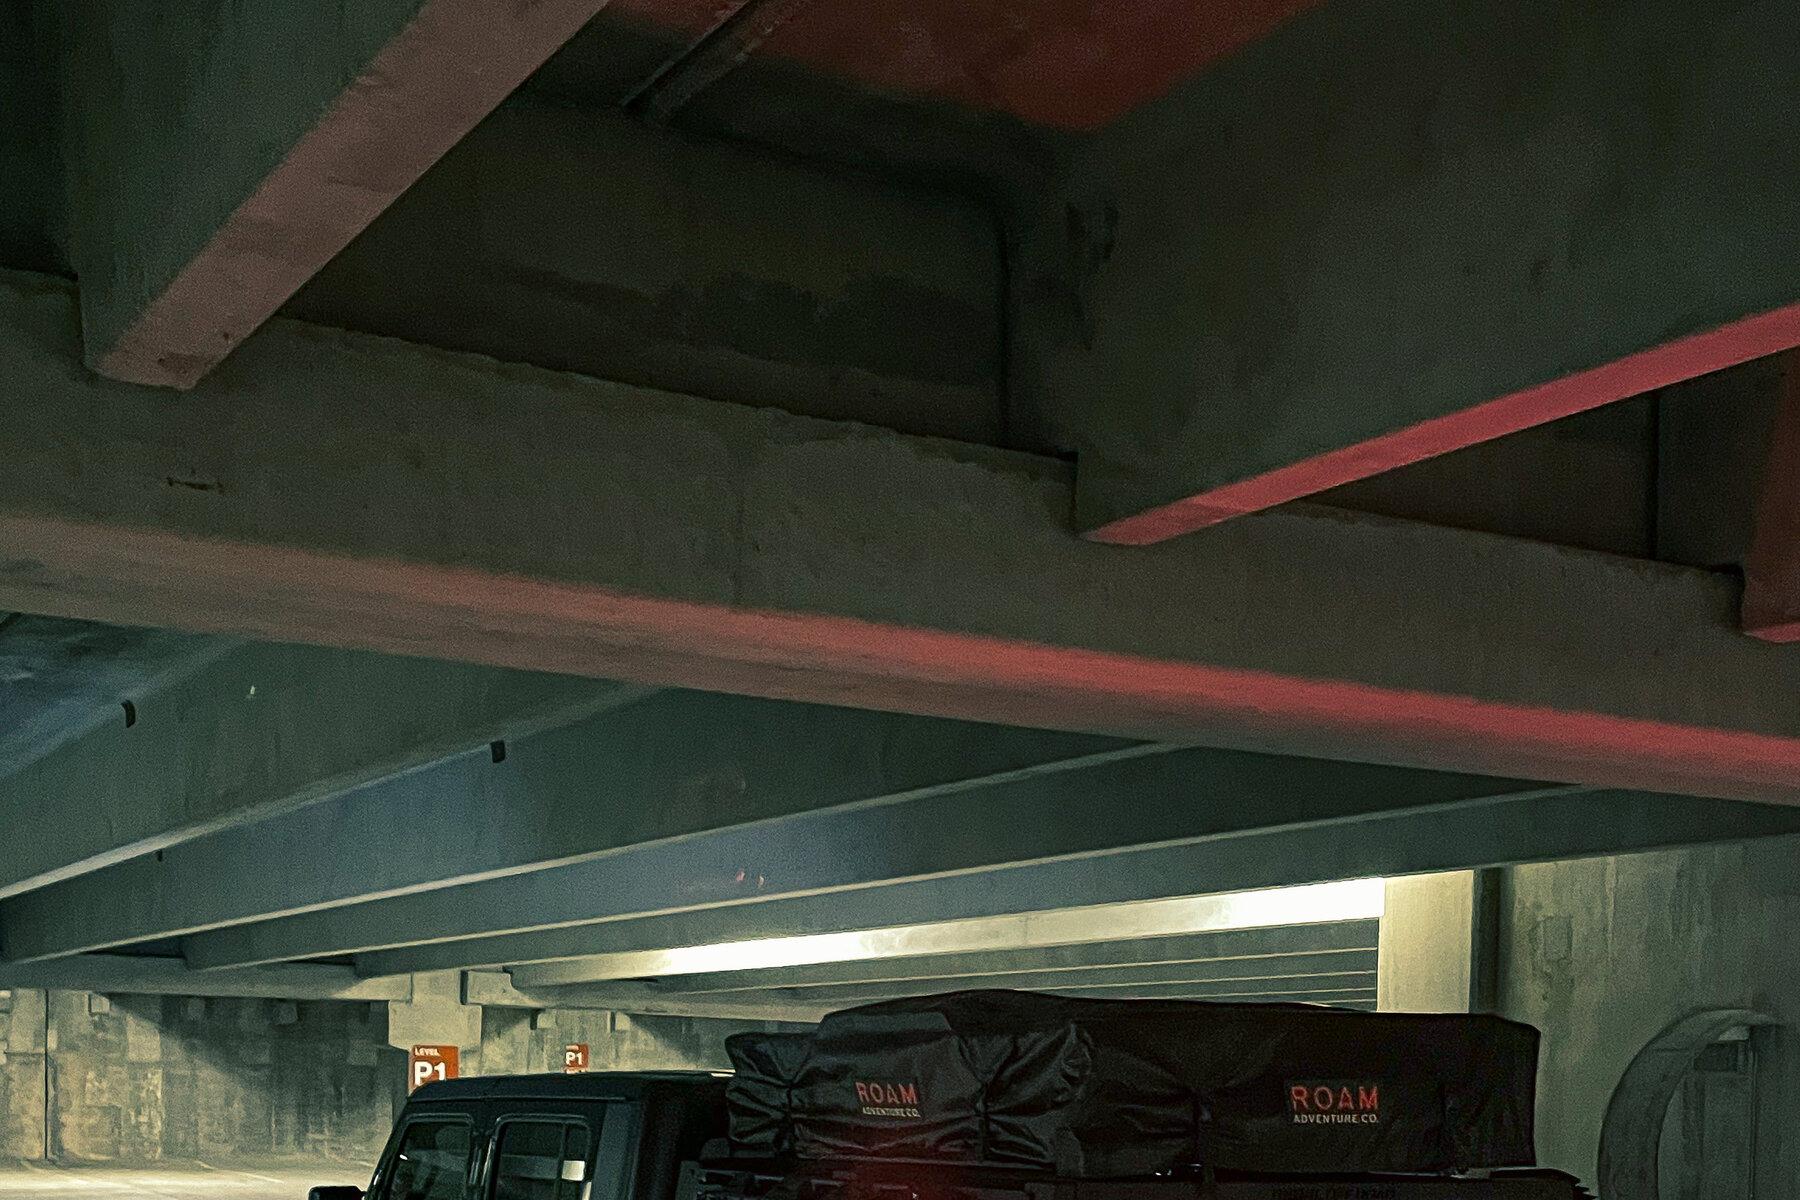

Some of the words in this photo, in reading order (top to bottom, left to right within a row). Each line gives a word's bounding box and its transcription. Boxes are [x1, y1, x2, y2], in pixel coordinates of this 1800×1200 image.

[565, 1052, 583, 1066] P1
[414, 1061, 446, 1087] P1
[855, 1081, 918, 1105] ROAM
[1291, 1086, 1378, 1111] ROAM
[1293, 1113, 1358, 1124] ADVENTURE
